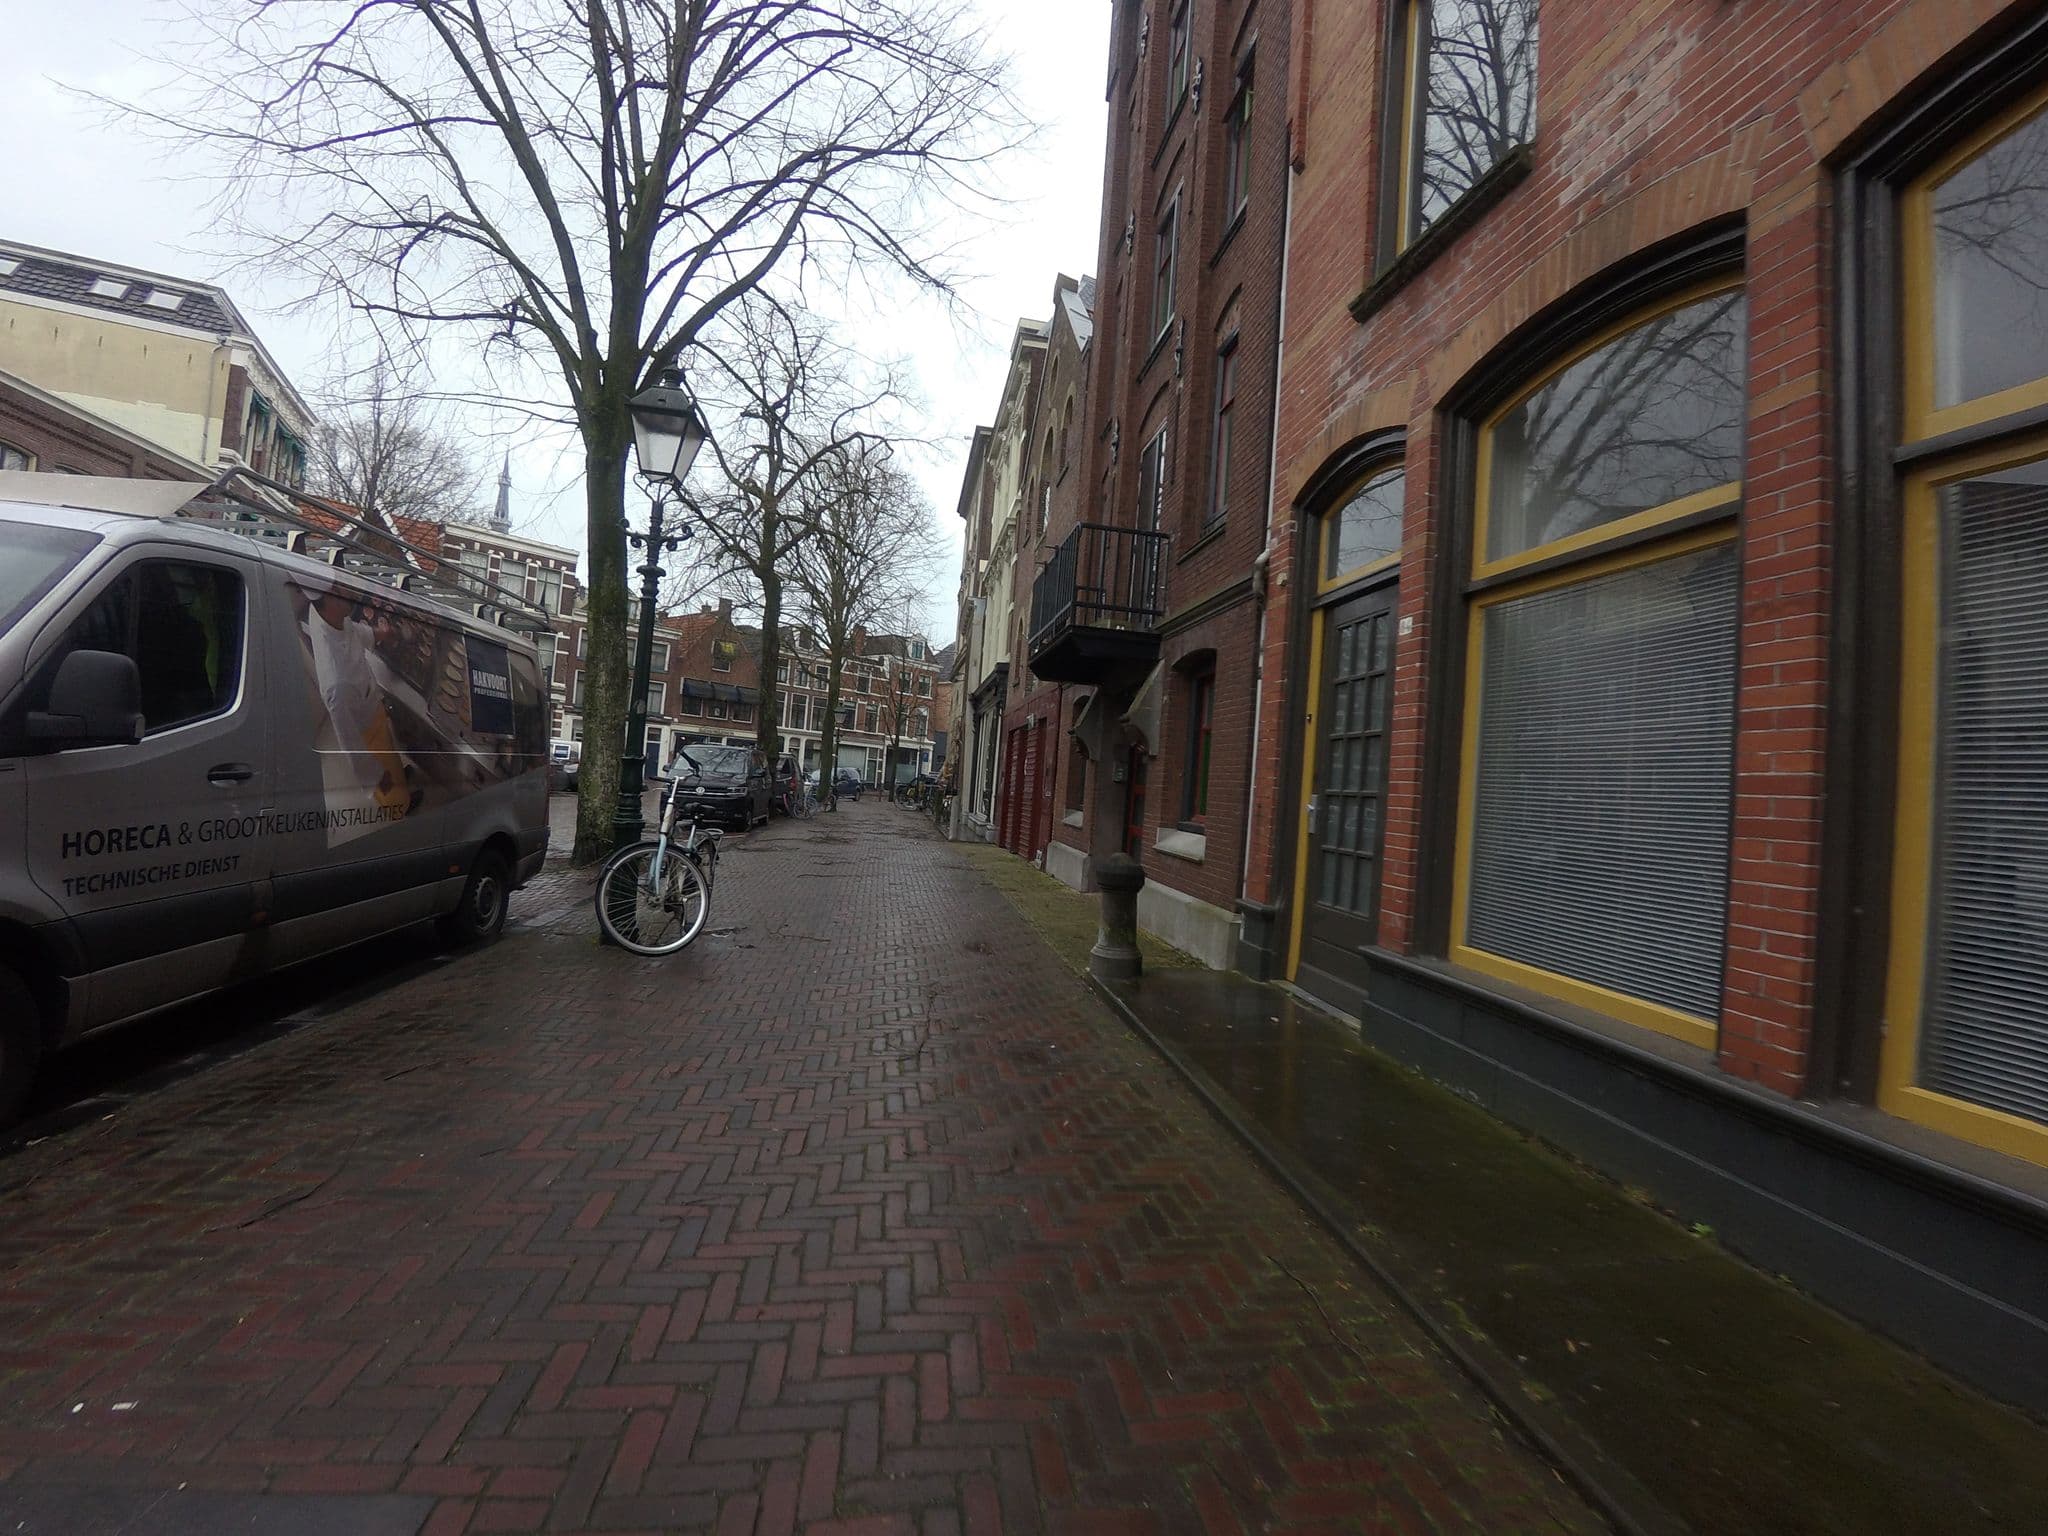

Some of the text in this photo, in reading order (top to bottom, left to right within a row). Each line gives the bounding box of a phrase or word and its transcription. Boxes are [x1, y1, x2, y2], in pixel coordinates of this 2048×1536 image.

[472, 669, 507, 691] HAKVOORT
[62, 804, 405, 859] HORECA & GROOTKEUKENINSTALLATIES
[62, 855, 240, 897] TECHNISCHE DIENST
